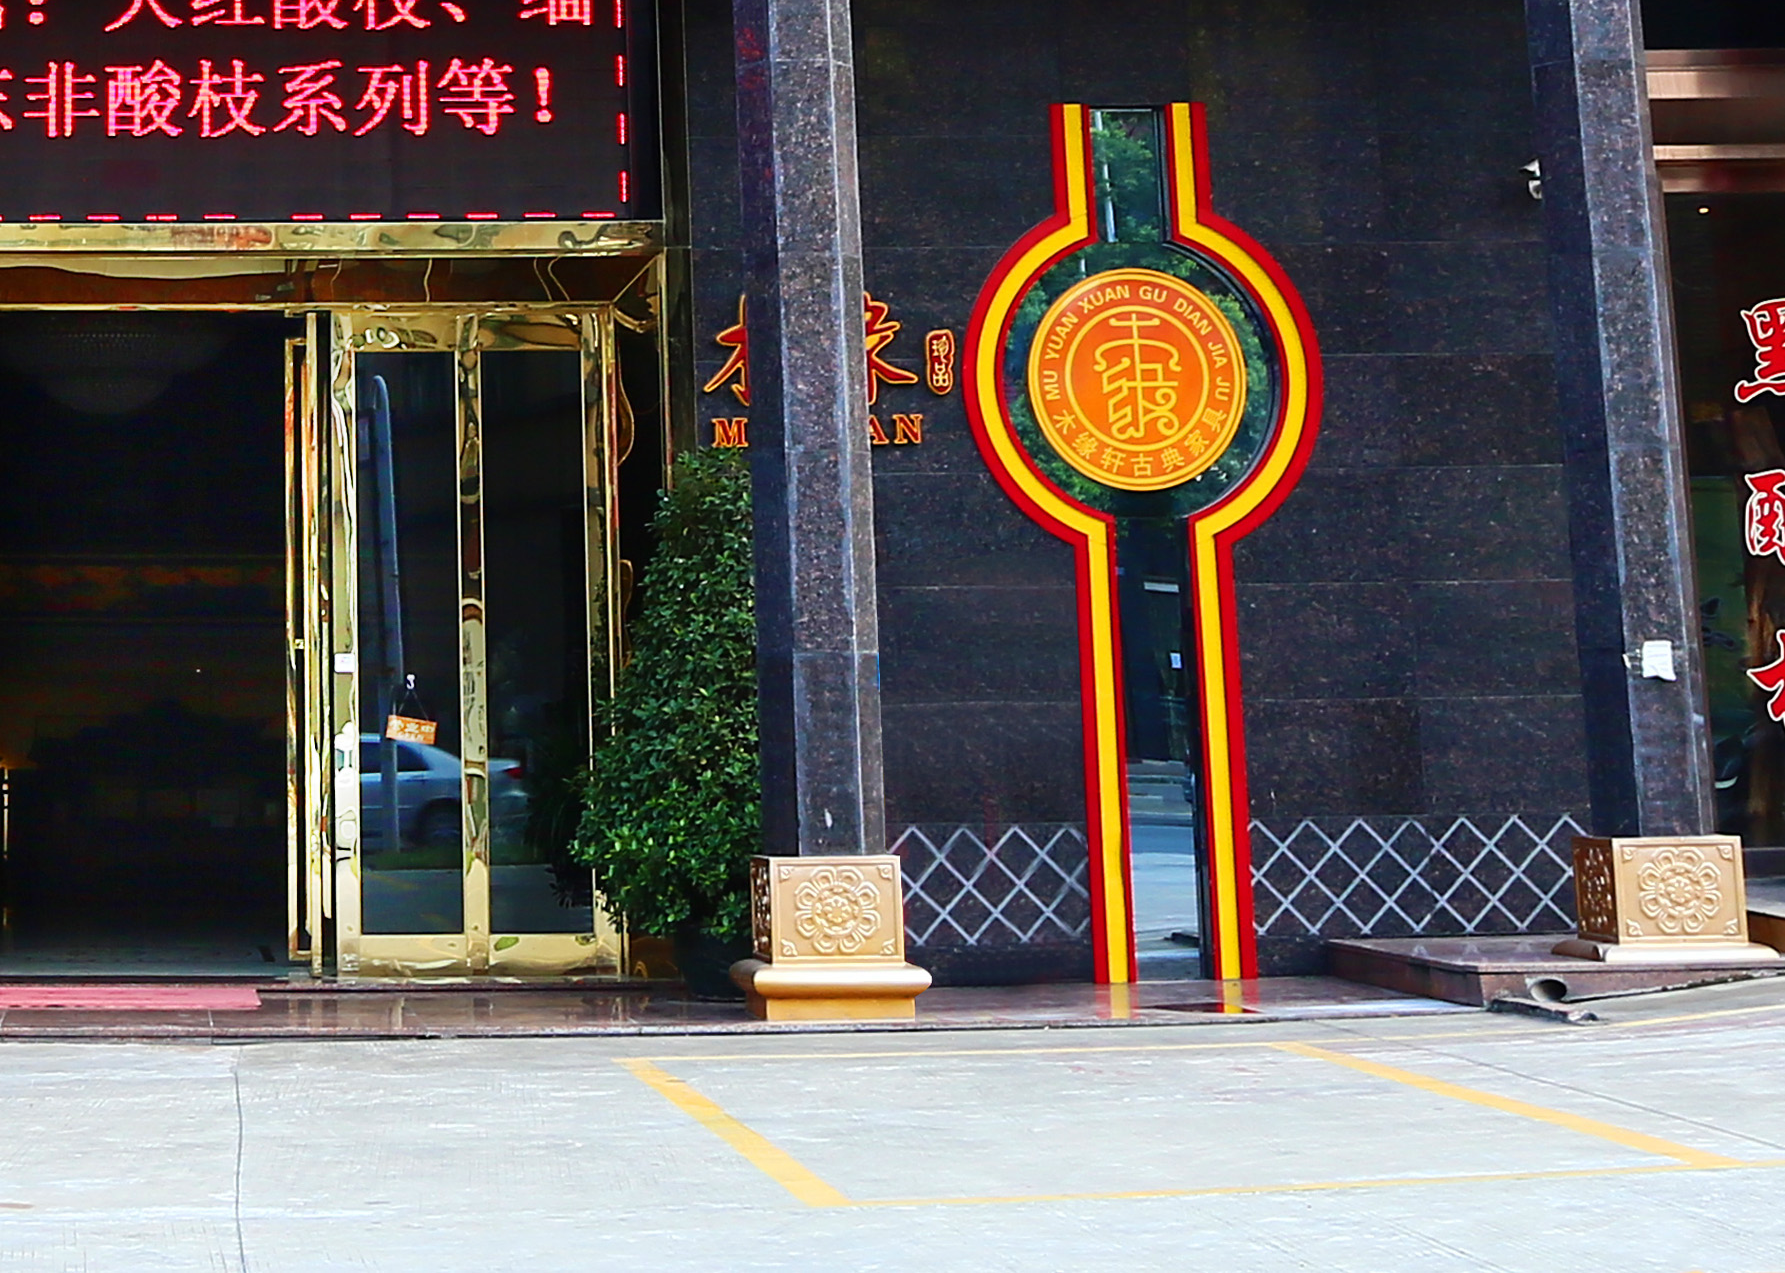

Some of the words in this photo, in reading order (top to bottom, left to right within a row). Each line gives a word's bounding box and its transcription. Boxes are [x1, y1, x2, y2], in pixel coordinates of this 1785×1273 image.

[1077, 285, 1131, 314] XUAN
[1138, 285, 1168, 304] GU
[1172, 297, 1213, 336] DIAN
[1045, 311, 1080, 361] YUAN
[1207, 340, 1229, 369] JIA
[1043, 370, 1061, 401] MU
[1214, 376, 1231, 401] JU
[1052, 406, 1228, 477] 木缘轩古典家具
